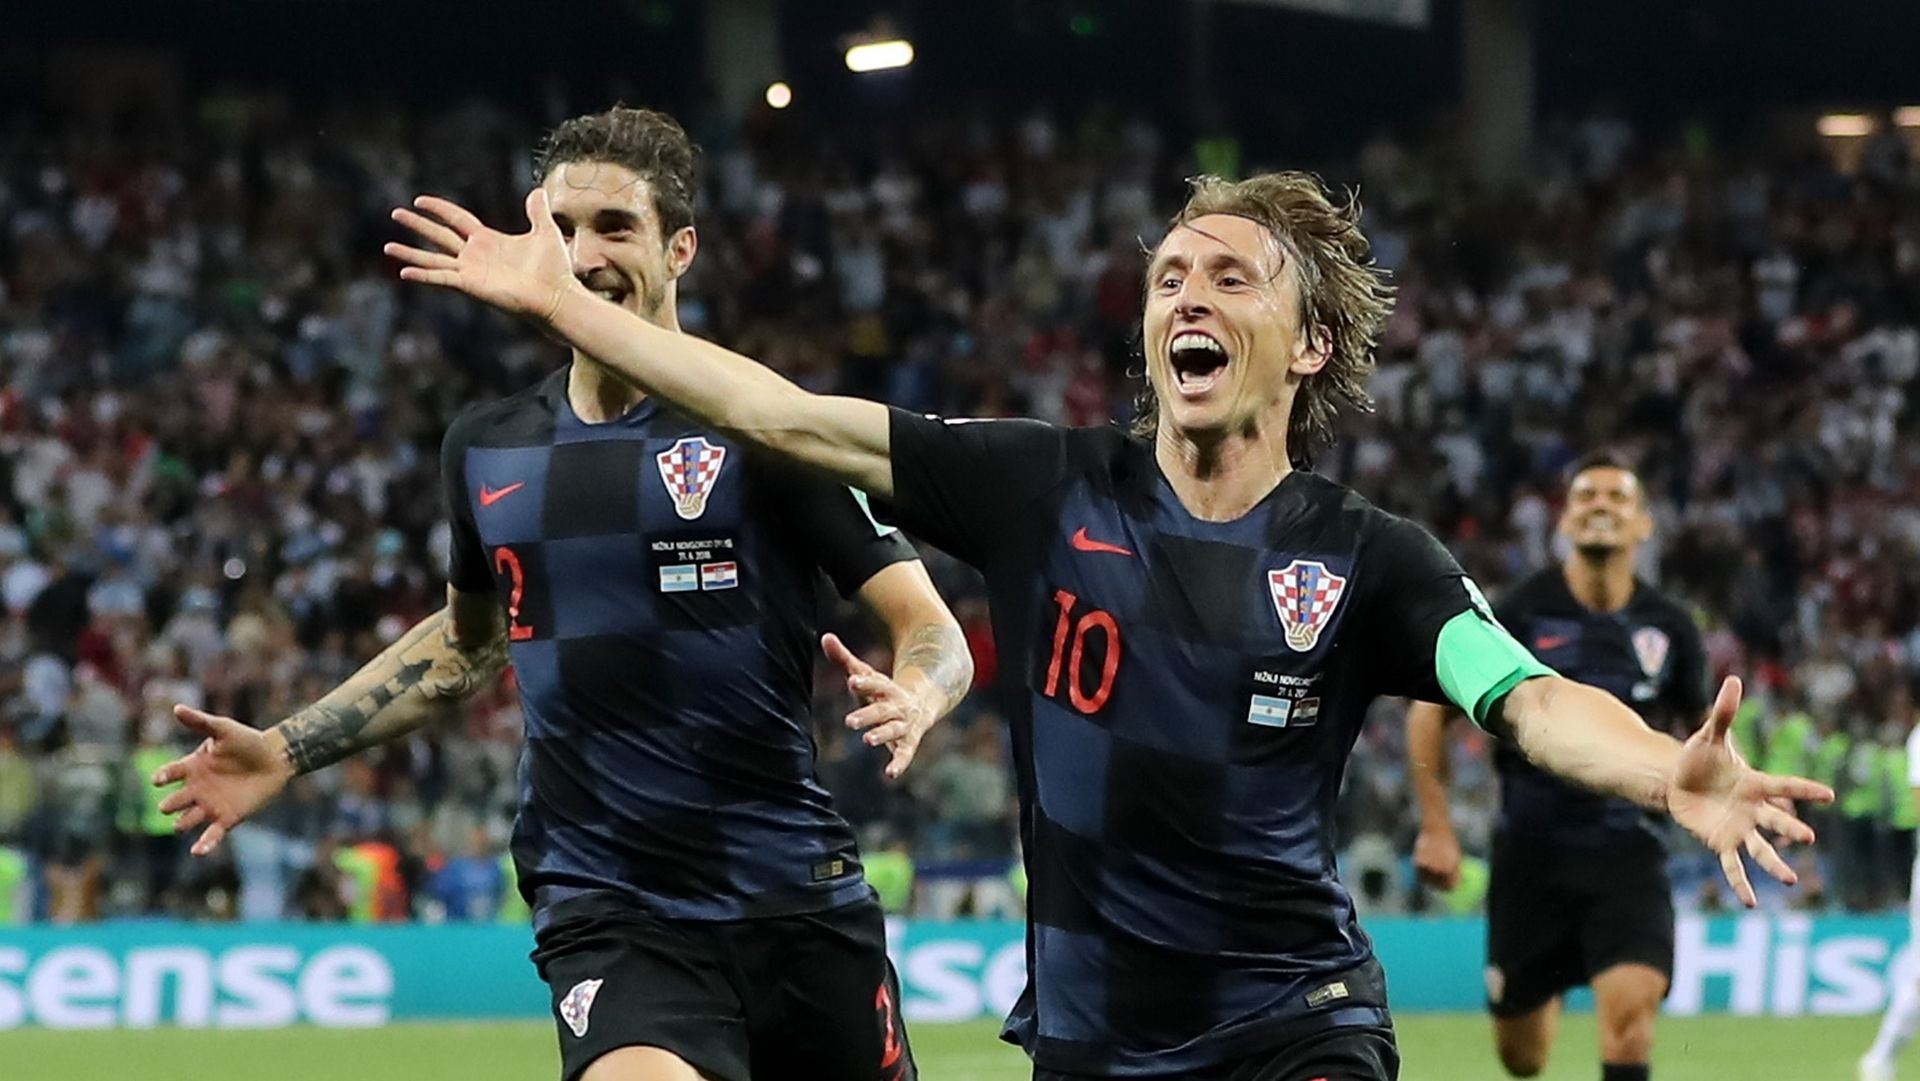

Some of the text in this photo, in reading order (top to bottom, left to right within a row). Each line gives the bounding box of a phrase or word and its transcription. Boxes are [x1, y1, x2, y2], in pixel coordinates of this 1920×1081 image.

[494, 547, 534, 640] 2
[1043, 589, 1121, 714] 10
[1664, 911, 1886, 1017] His
